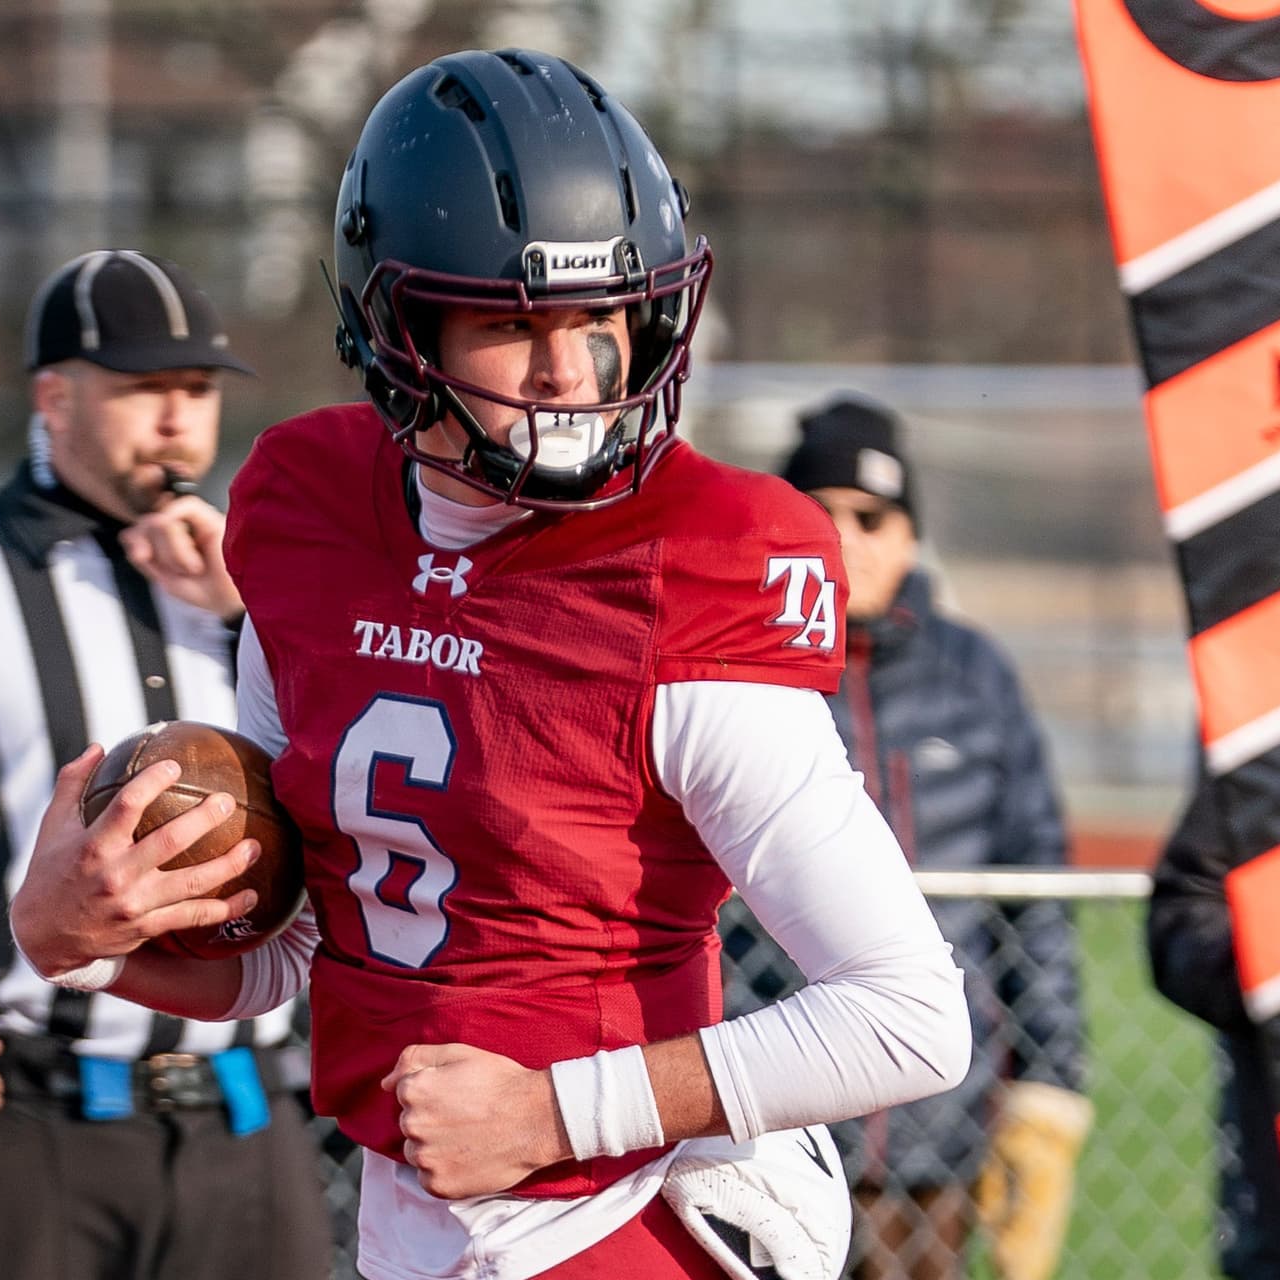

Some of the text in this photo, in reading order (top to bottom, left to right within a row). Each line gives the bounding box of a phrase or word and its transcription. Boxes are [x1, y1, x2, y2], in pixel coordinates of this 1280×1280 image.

[551, 255, 609, 270] LIGHT
[763, 556, 837, 650] TA
[353, 619, 484, 677] TABOR
[330, 690, 459, 969] 6
